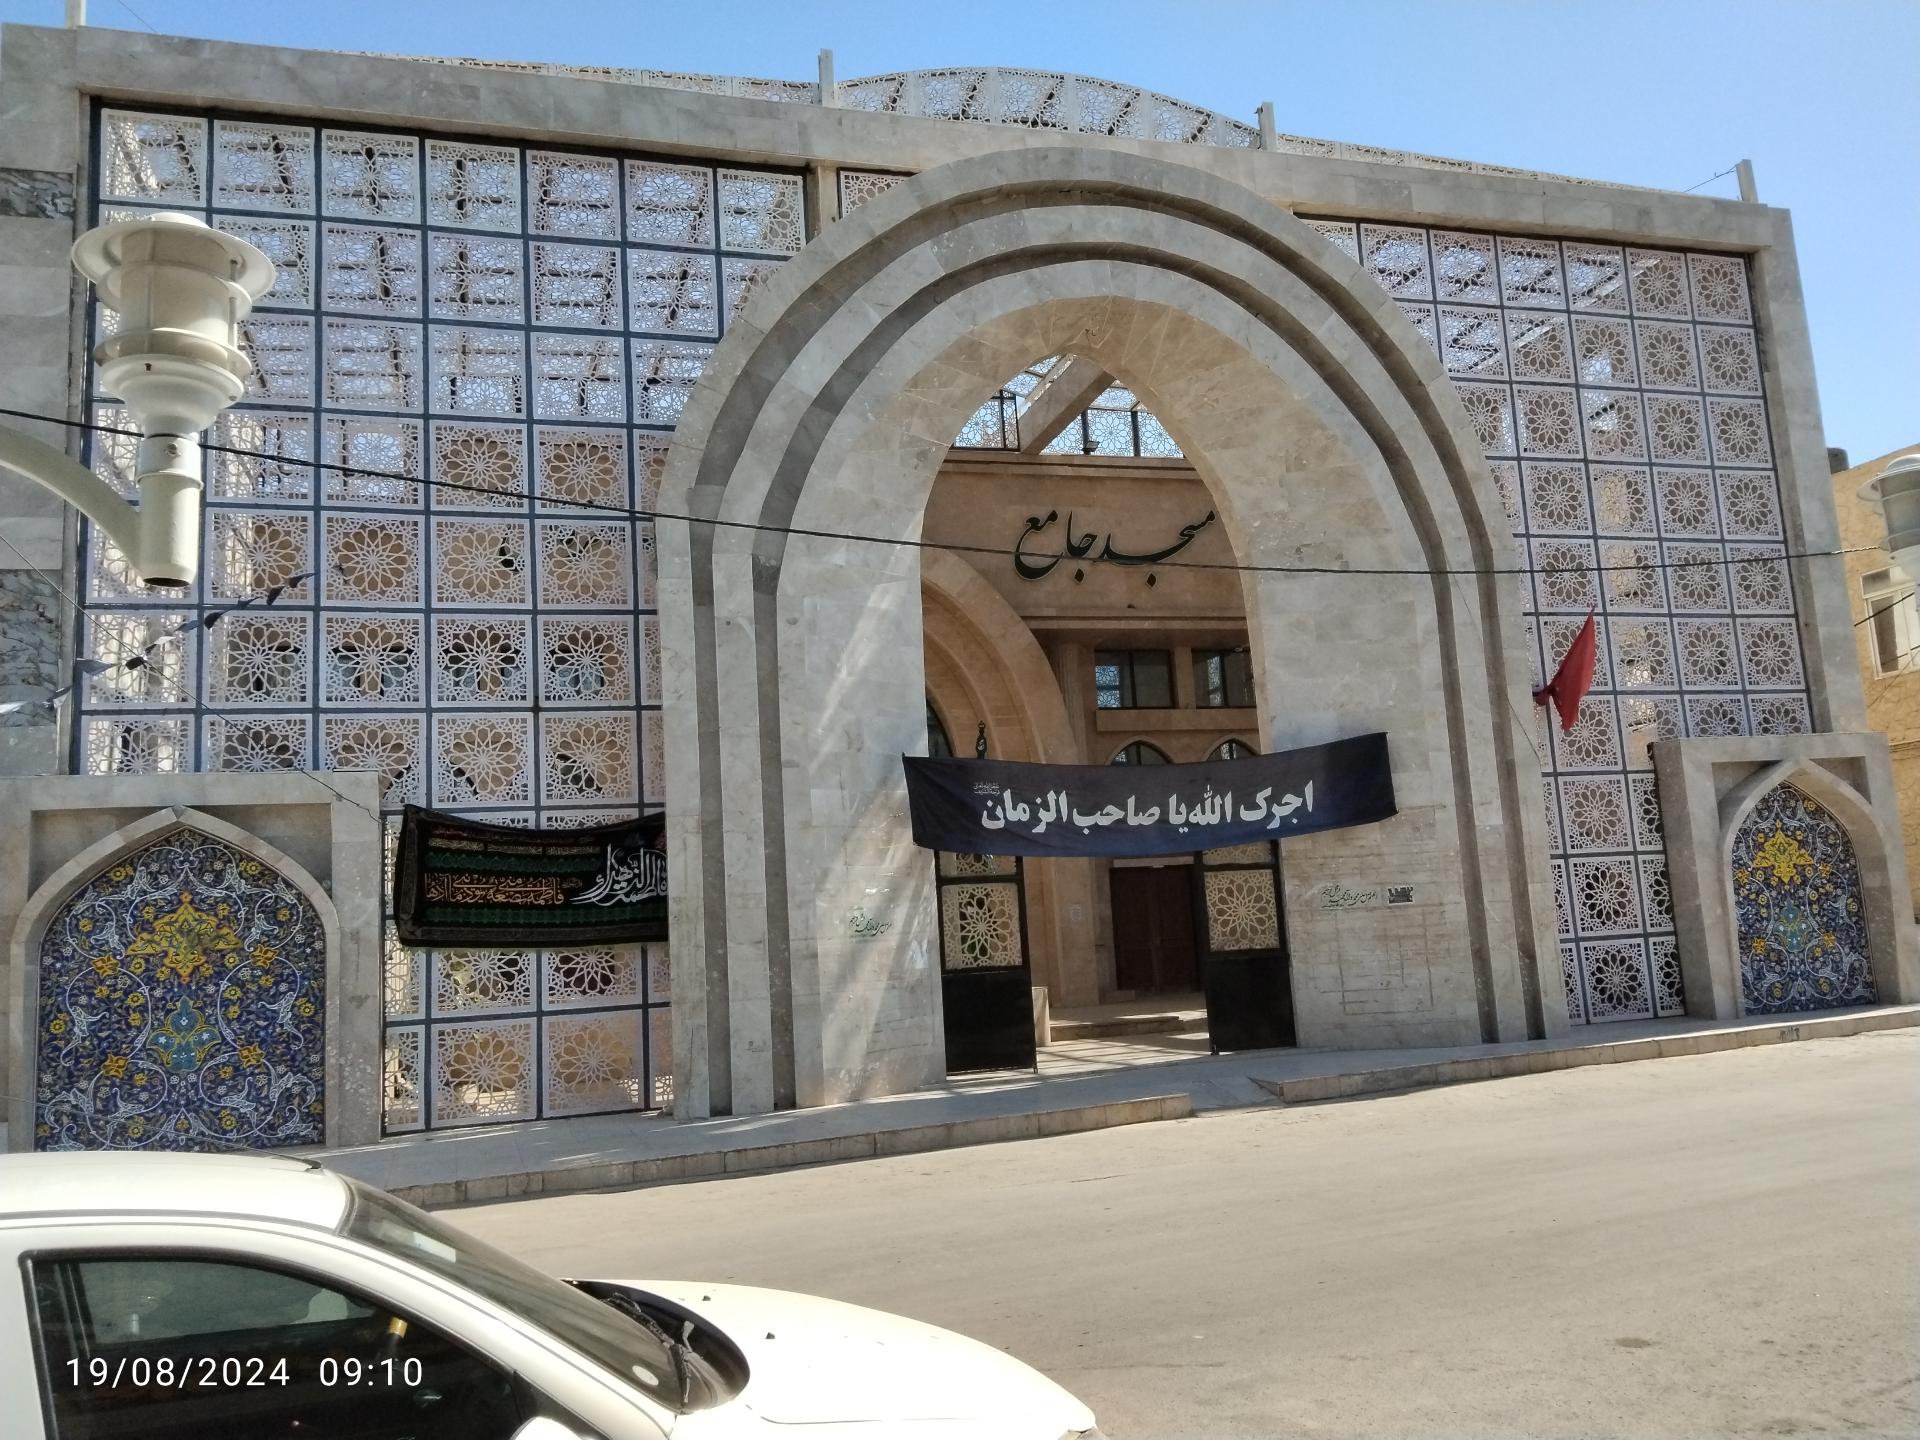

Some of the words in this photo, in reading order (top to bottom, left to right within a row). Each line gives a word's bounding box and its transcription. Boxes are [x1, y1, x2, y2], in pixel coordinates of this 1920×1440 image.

[1013, 509, 1099, 583] جامع
[1099, 509, 1217, 588] مسجد
[981, 788, 1068, 833] الزمان
[1072, 794, 1161, 835] صاحب
[1168, 793, 1189, 834] یا
[1188, 784, 1233, 826] الله
[1239, 779, 1314, 830] اجرک
